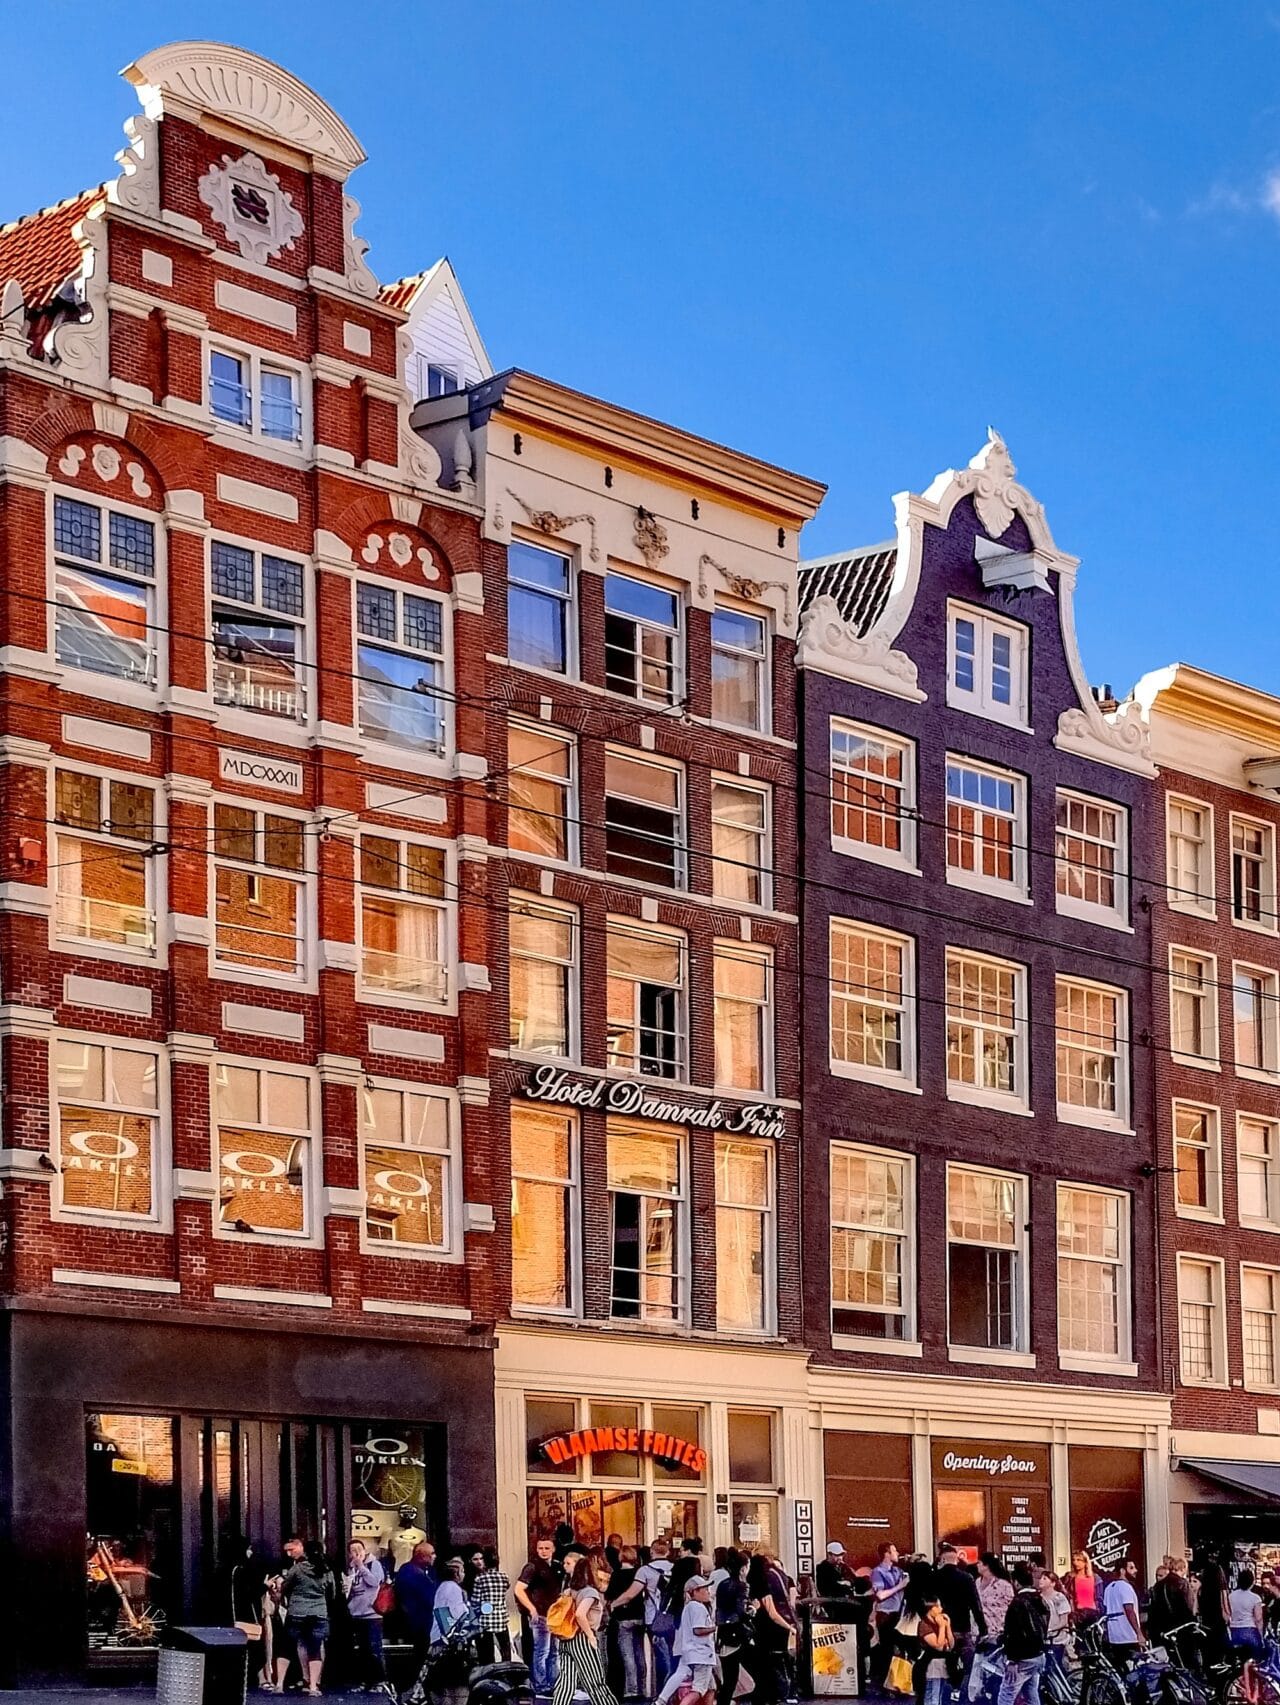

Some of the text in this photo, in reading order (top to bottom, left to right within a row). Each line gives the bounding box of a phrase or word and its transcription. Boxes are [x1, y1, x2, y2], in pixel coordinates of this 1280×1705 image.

[223, 758, 298, 787] MDCXXXII
[526, 1065, 787, 1139] Hotel Damrak Inn
[70, 1155, 150, 1178] AKLEY
[222, 1176, 304, 1197] AKLEY
[372, 1192, 443, 1216] AKLEY
[355, 1455, 419, 1465] OAKLEY
[544, 1427, 707, 1472] VLAAMSE FRITES
[943, 1452, 1037, 1475] Opening Soon
[1016, 1507, 1026, 1515] USA
[799, 1505, 810, 1571] HOTE
